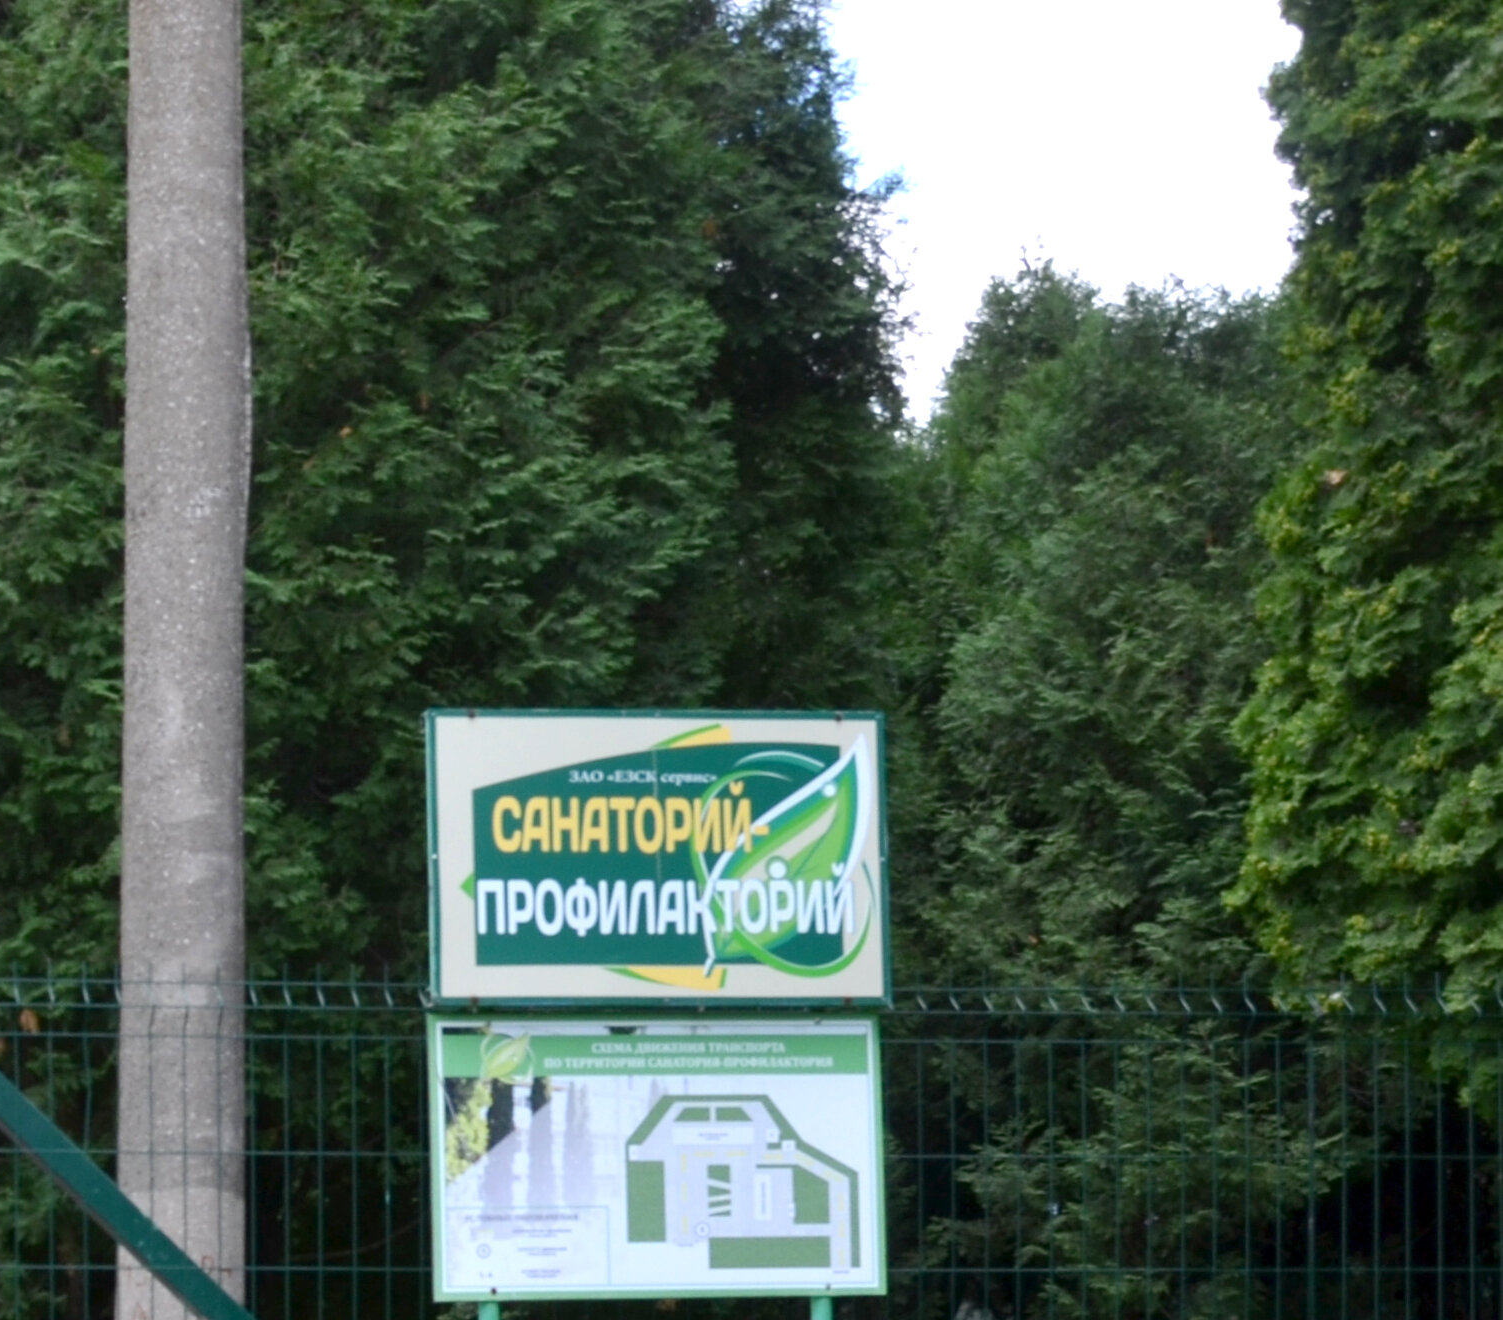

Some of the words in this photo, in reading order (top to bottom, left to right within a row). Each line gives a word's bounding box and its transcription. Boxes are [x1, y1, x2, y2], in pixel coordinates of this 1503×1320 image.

[569, 770, 604, 783] ЗАО
[660, 772, 718, 786] сервис»
[492, 781, 769, 854] САНАТОРИЙ-
[476, 862, 855, 936] ПРОФИЛАКТОРИЙ
